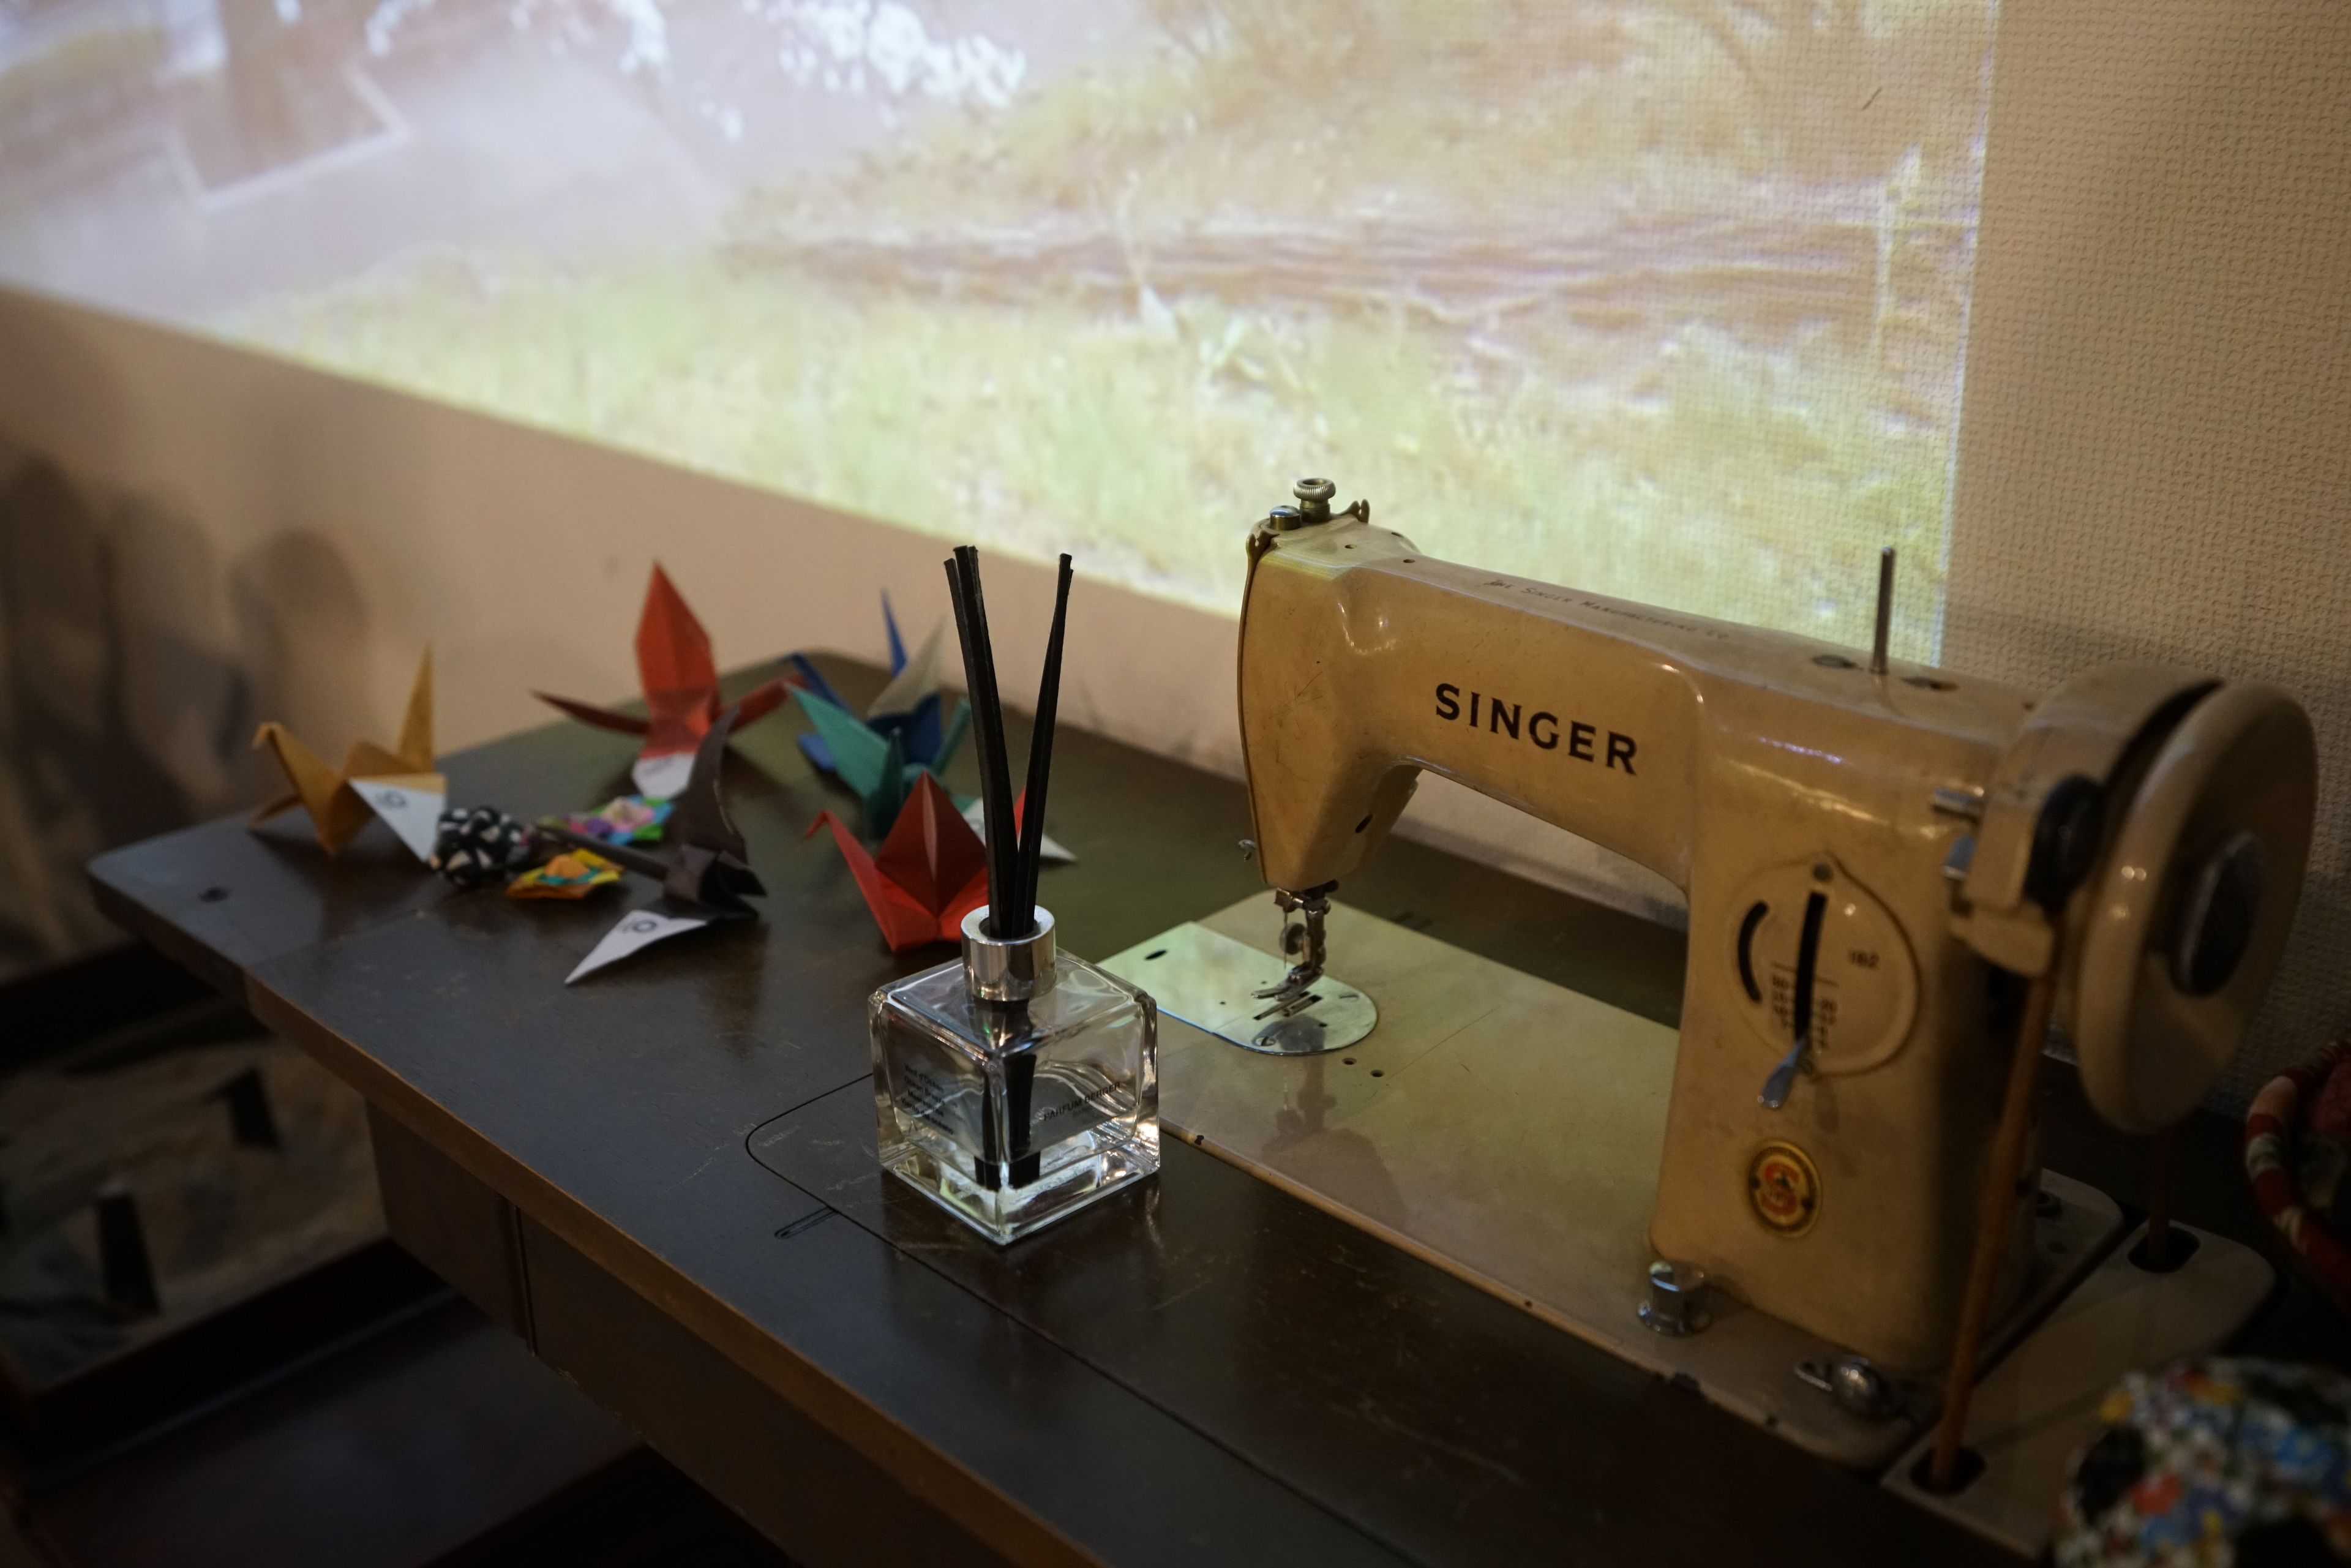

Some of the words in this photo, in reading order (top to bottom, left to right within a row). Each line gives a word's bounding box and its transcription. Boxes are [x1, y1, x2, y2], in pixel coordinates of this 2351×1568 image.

[1521, 587, 1573, 603] SINGER
[1436, 683, 1637, 776] SINGER
[1044, 1098, 1082, 1121] PARFUM
[1084, 1082, 1120, 1103] BERGER
